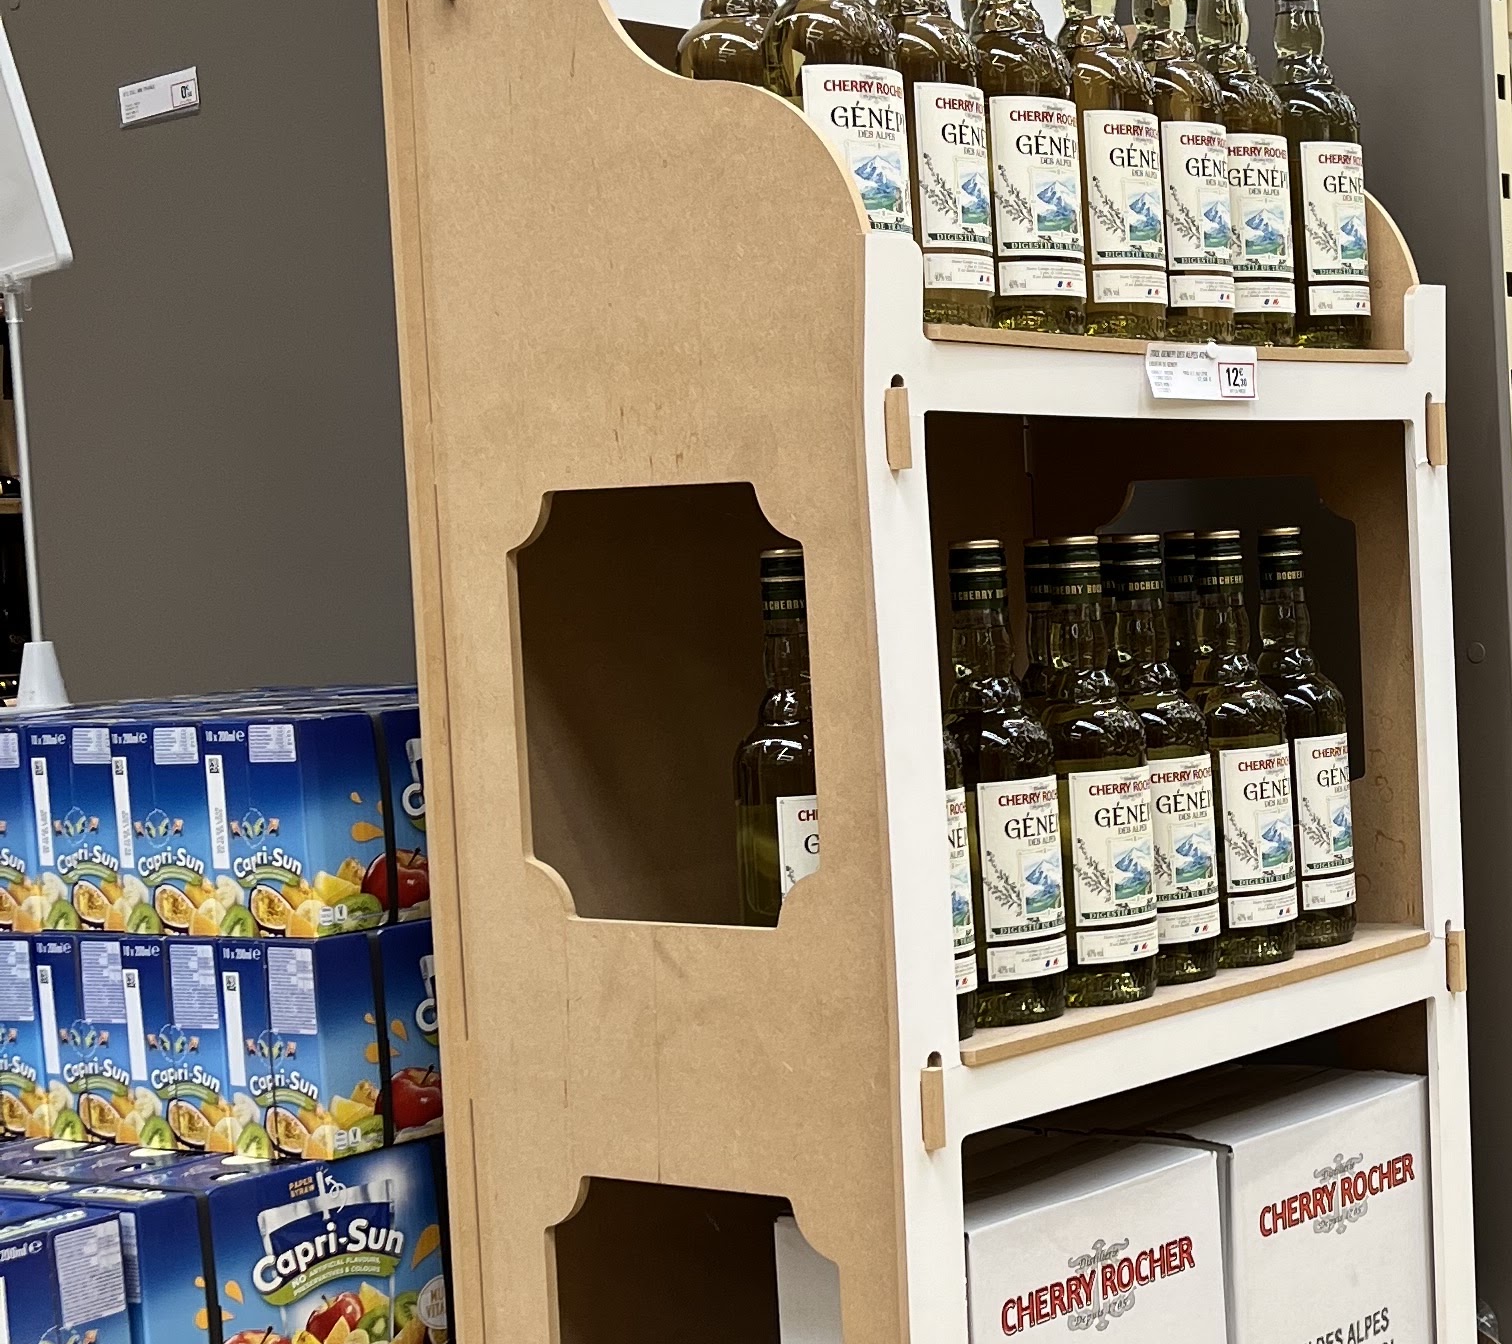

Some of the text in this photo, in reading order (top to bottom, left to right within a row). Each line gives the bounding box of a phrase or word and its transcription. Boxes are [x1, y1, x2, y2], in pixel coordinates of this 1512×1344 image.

[823, 78, 875, 95] CHERRY
[935, 96, 975, 113] CHERRY
[1009, 109, 1054, 124] CHERRY
[1103, 123, 1144, 137] CHERRY
[1179, 134, 1217, 148] CHERRY
[1227, 145, 1262, 158] HERRY
[1317, 153, 1352, 166] CHERRY
[1311, 746, 1342, 759] CHERRY
[1238, 758, 1276, 772] CHERRY
[1150, 770, 1192, 785] CHERRY
[1088, 782, 1133, 797] CHERRY
[998, 791, 1041, 807] CHERRY
[56, 843, 119, 875] Capri-Sun
[137, 845, 205, 879] Capri-Sun
[232, 846, 303, 880] Capri-Sun
[63, 1054, 130, 1087] Capri-Sun
[150, 1061, 222, 1094] Capri-Sun
[249, 1067, 320, 1100] Capri-Sun
[1259, 1153, 1416, 1238] CHERRY ROCHER
[252, 1217, 405, 1294] Capri-Sun
[291, 1273, 308, 1290] NO
[1001, 1235, 1197, 1337] CHERRY ROCHER
